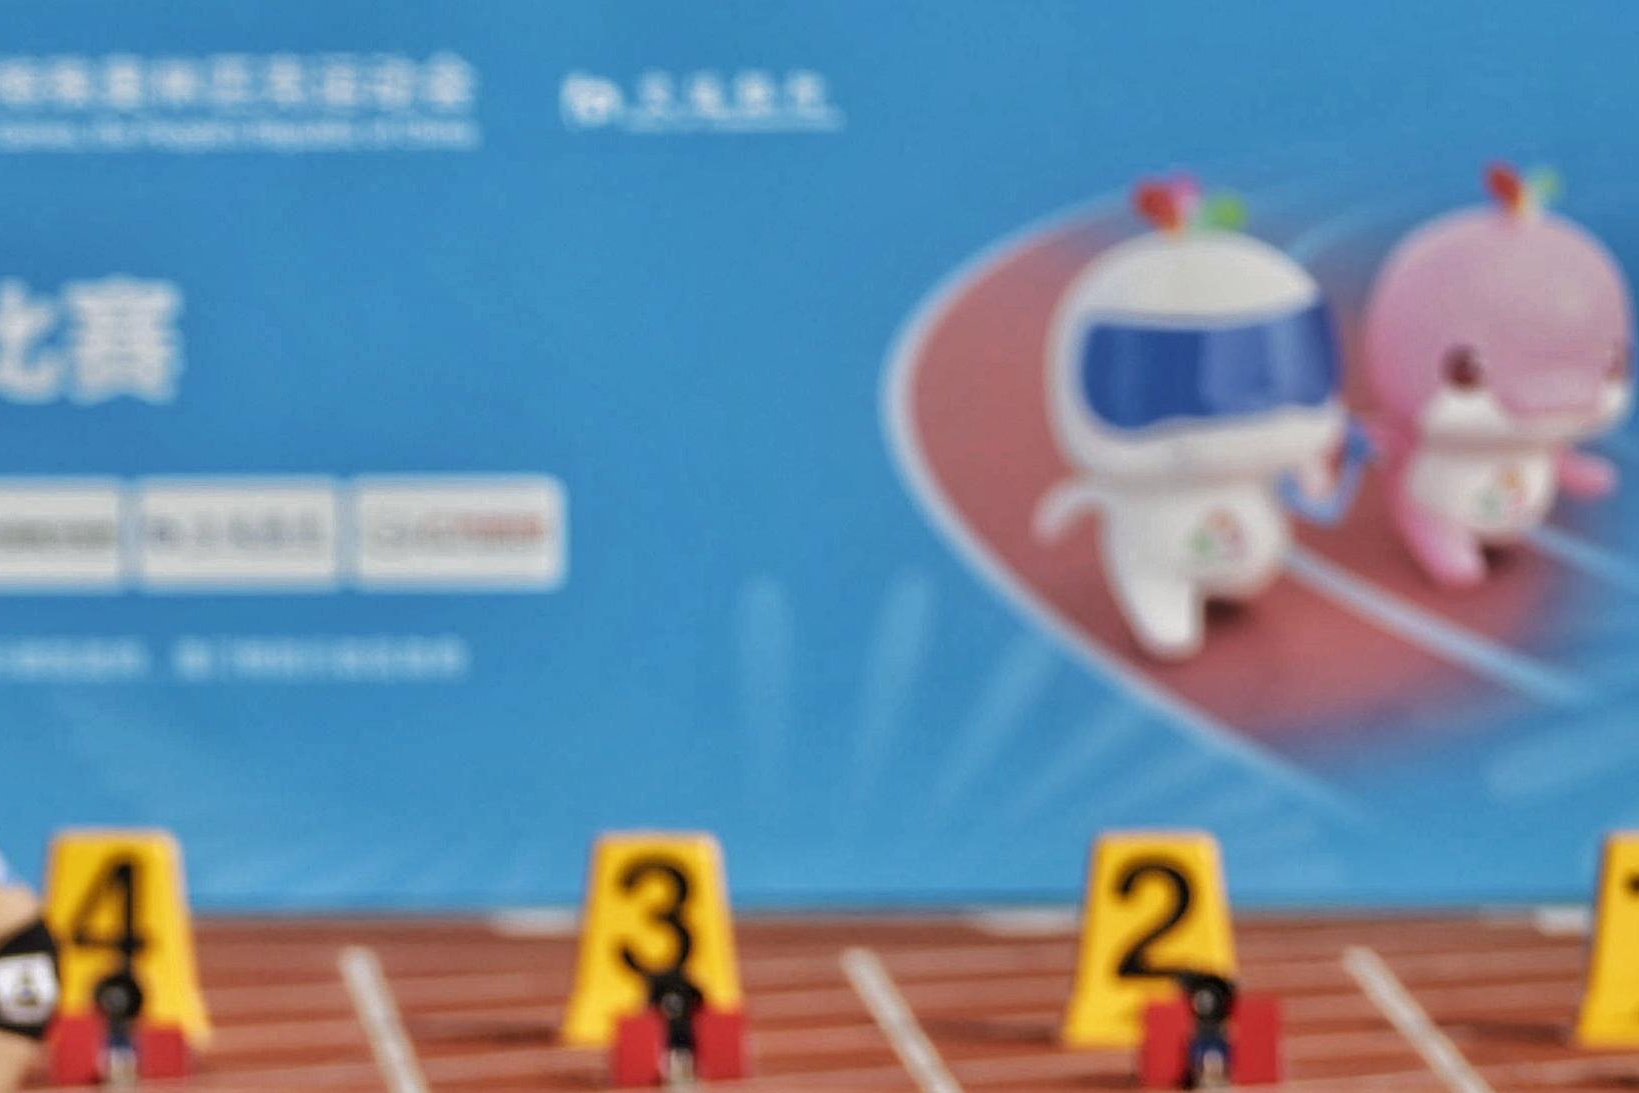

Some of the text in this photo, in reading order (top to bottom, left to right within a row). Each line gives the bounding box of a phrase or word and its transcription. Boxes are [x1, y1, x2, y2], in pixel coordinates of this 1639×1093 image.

[72, 853, 149, 974] 4
[616, 855, 694, 978] 3
[1115, 856, 1197, 979] 2
